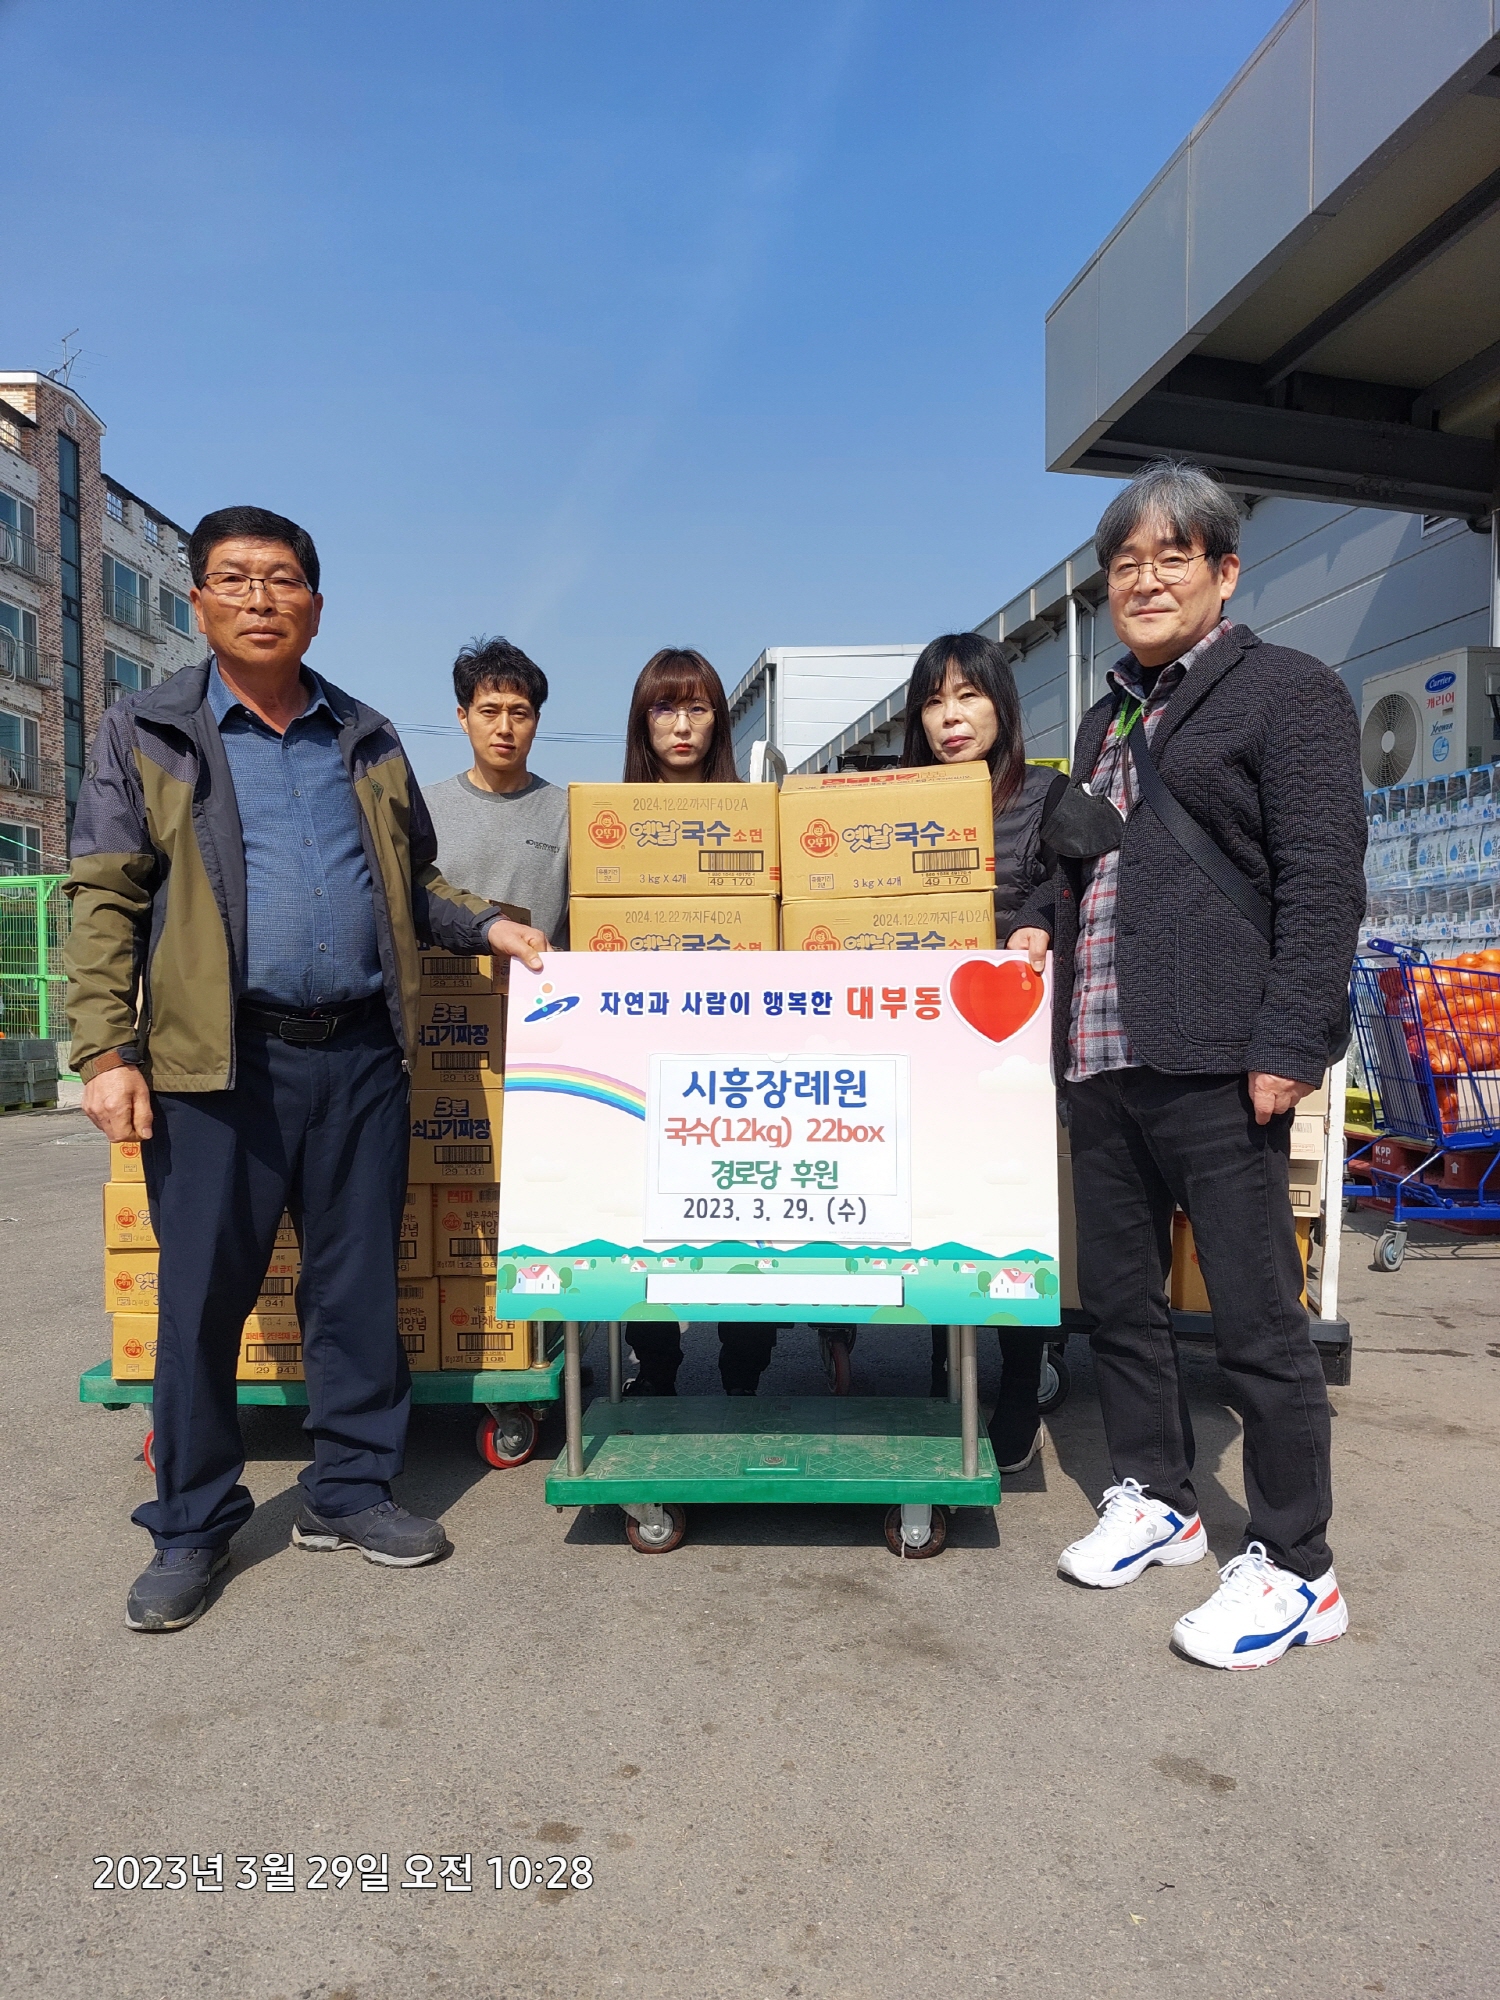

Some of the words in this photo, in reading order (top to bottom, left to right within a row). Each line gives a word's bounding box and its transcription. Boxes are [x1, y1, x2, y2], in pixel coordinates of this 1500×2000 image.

[1428, 675, 1452, 689] Carrier
[1426, 692, 1455, 709] 캐리어
[733, 828, 763, 843] 소면
[946, 826, 978, 842] 소면
[807, 836, 834, 849] 오뚜기
[639, 874, 645, 884] 3
[647, 873, 660, 885] kg
[672, 873, 687, 884] 4개
[709, 878, 724, 886] 49
[732, 878, 753, 886] 170
[853, 879, 859, 888] 3
[861, 878, 875, 890] kg
[886, 876, 902, 887] 4개
[925, 877, 940, 886] 49
[947, 876, 969, 885] 170
[600, 991, 670, 1016] 자연과
[681, 991, 751, 1016] 사람이
[763, 991, 833, 1016] 행복한
[846, 986, 942, 1020] 대부동
[432, 1002, 467, 1023] 3분
[682, 1067, 867, 1109] 시흥장례원
[433, 1096, 469, 1117] 3분
[412, 1119, 491, 1140] 쇠고기짜장
[664, 1116, 792, 1148] 국수(12kg)
[806, 1117, 885, 1143] 22box
[1375, 1145, 1391, 1158] KPP
[711, 1160, 782, 1190] 경로당
[791, 1159, 839, 1190] 후원
[683, 1197, 740, 1221] 2023.
[752, 1198, 771, 1221] 3.
[783, 1198, 814, 1221] 29.
[827, 1196, 867, 1225] (수)
[256, 1366, 270, 1374] 29
[277, 1366, 296, 1374] 941
